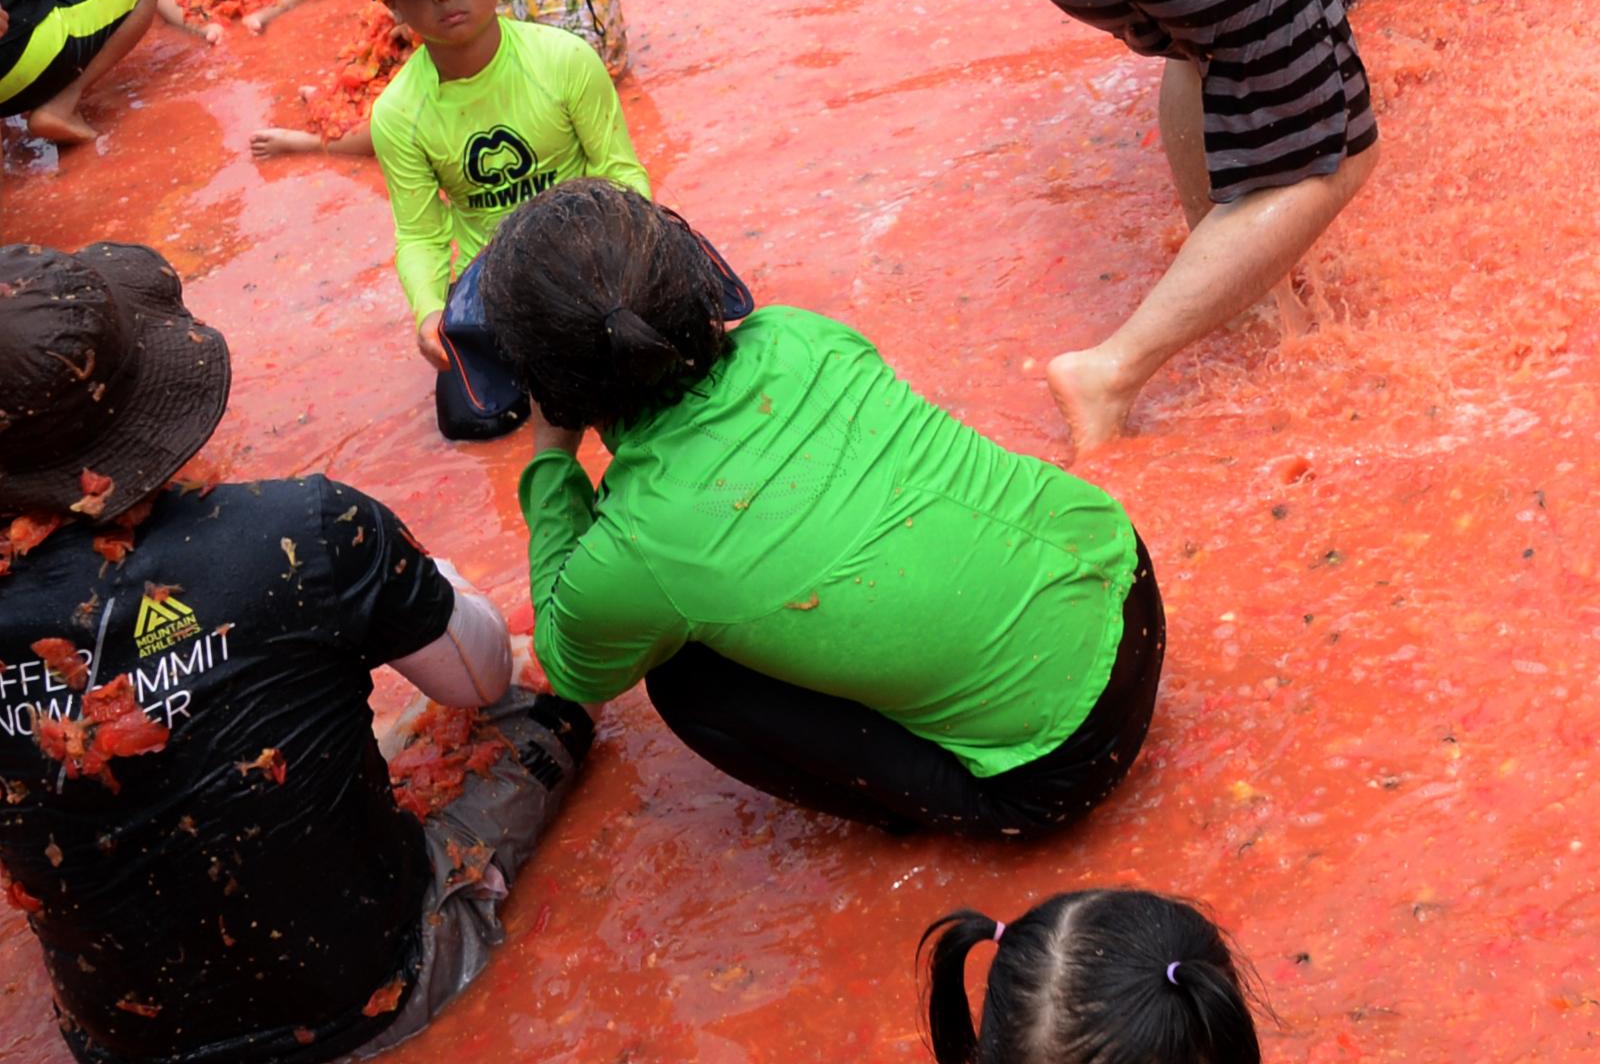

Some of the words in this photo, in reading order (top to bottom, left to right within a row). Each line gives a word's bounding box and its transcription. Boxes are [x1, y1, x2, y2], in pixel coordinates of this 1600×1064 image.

[136, 614, 197, 649] MOUNTAIN
[138, 625, 203, 659] ATHLETICS
[92, 622, 236, 703] MMIT
